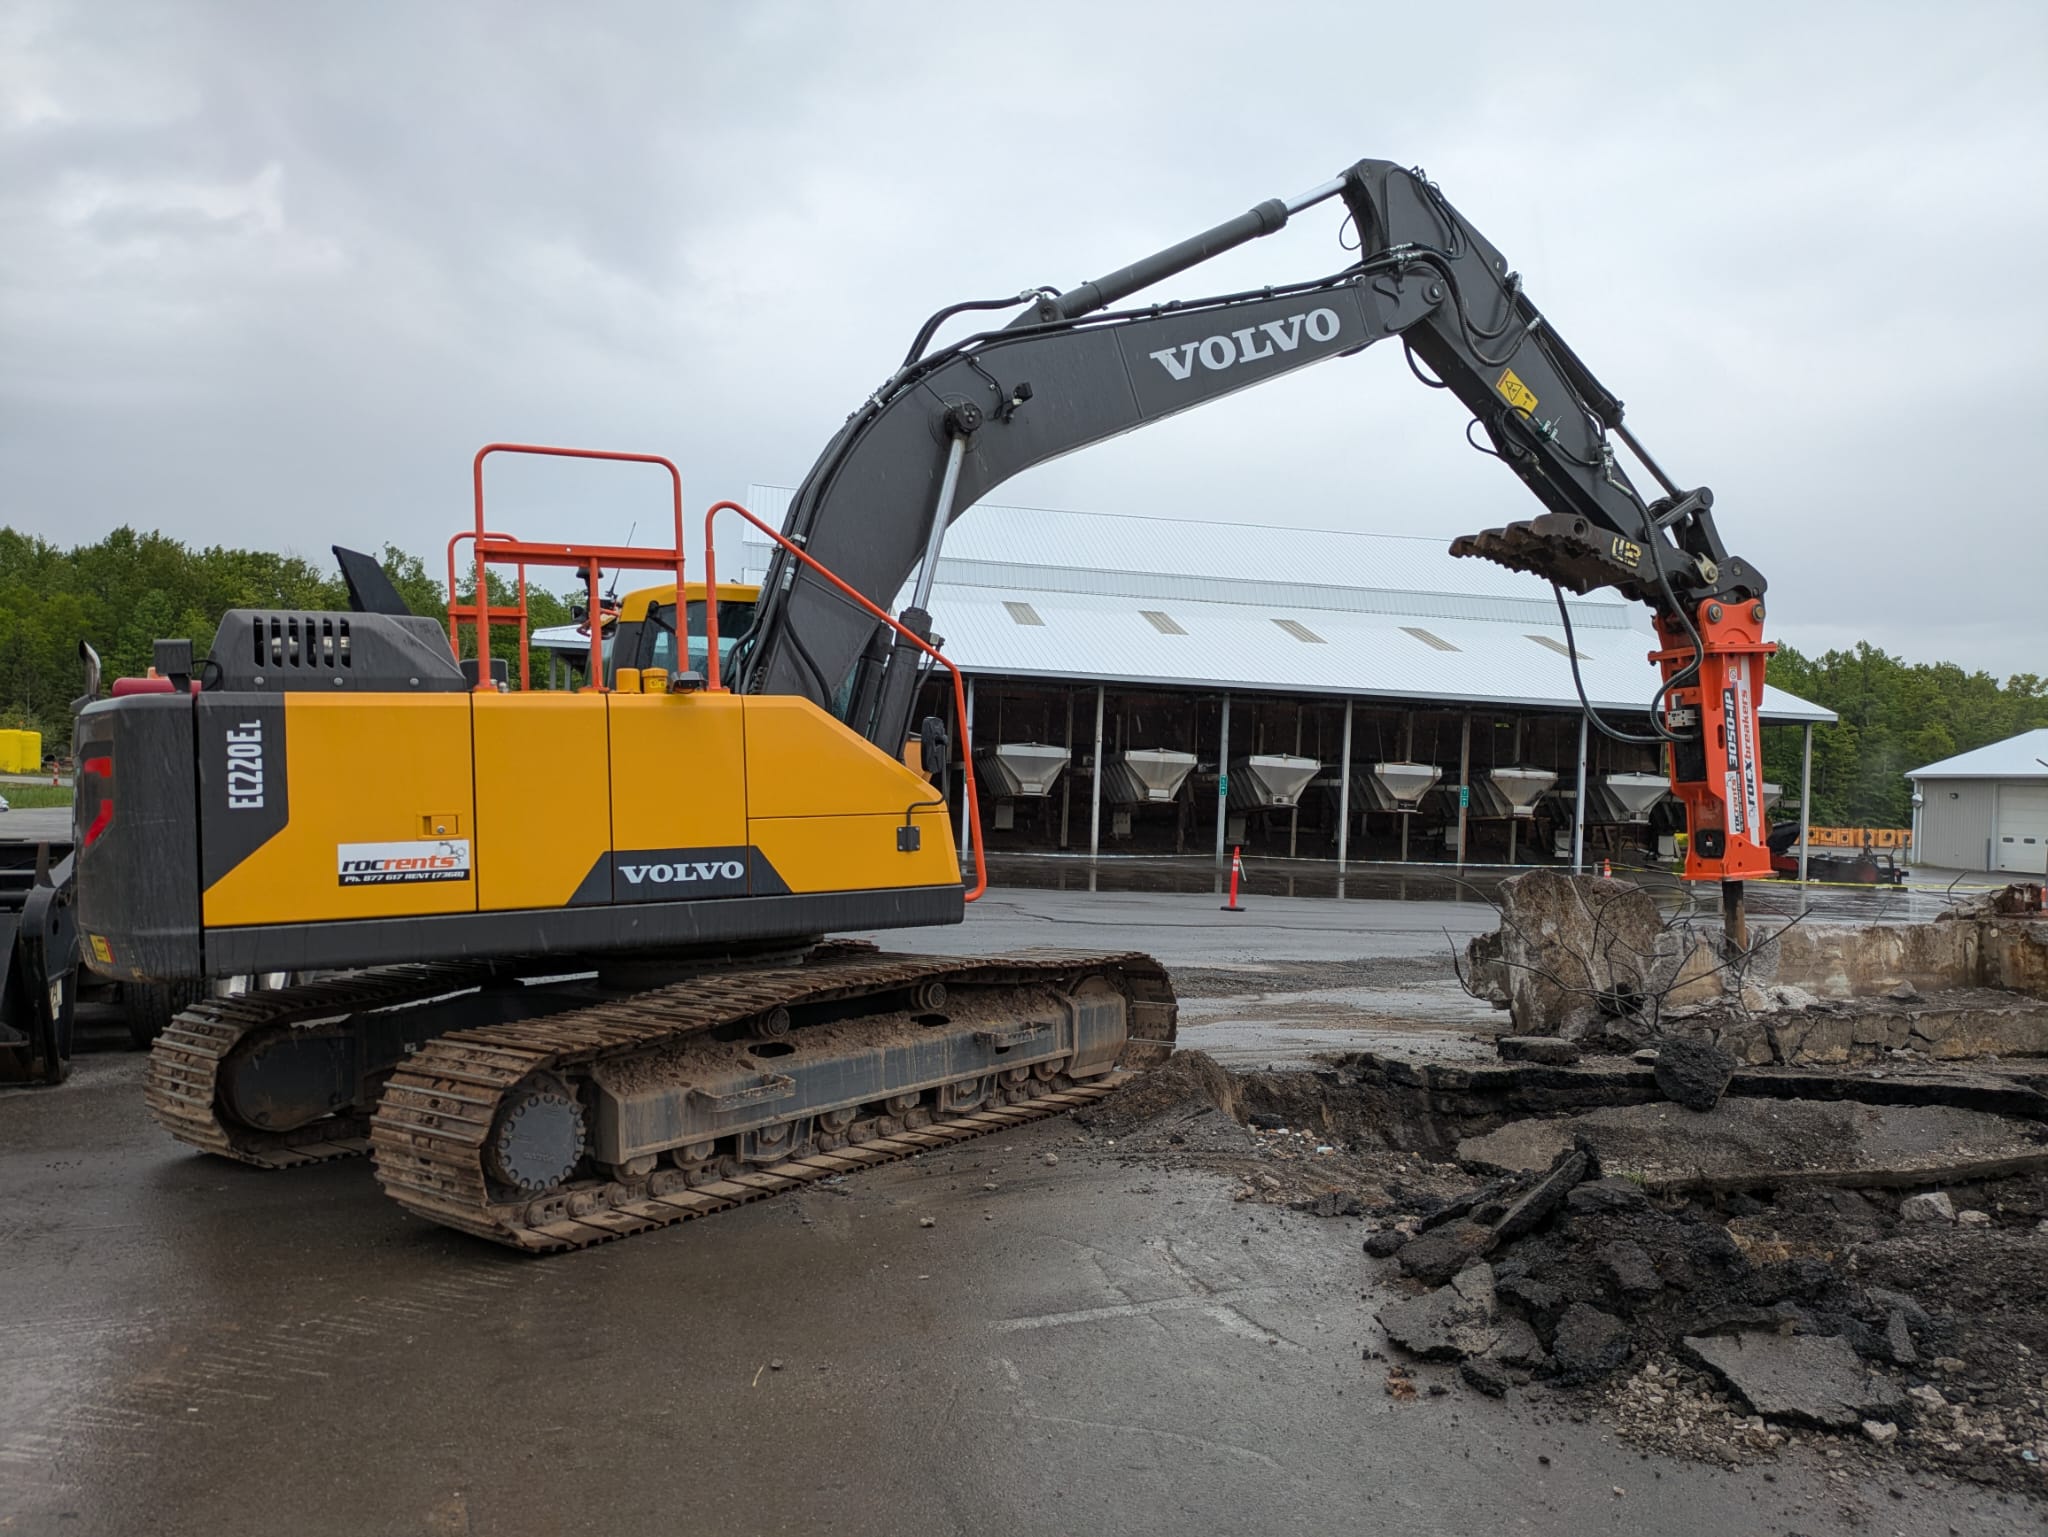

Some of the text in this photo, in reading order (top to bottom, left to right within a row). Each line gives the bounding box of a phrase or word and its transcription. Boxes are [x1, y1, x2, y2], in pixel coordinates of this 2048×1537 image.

[1150, 308, 1341, 381] VOLVO
[1724, 690, 1738, 768] 3050-IP
[226, 719, 264, 808] EC220EL
[342, 855, 455, 872] rocrents
[363, 874, 386, 882] 877
[404, 872, 430, 880] RENT
[618, 861, 744, 884] VOLVO
